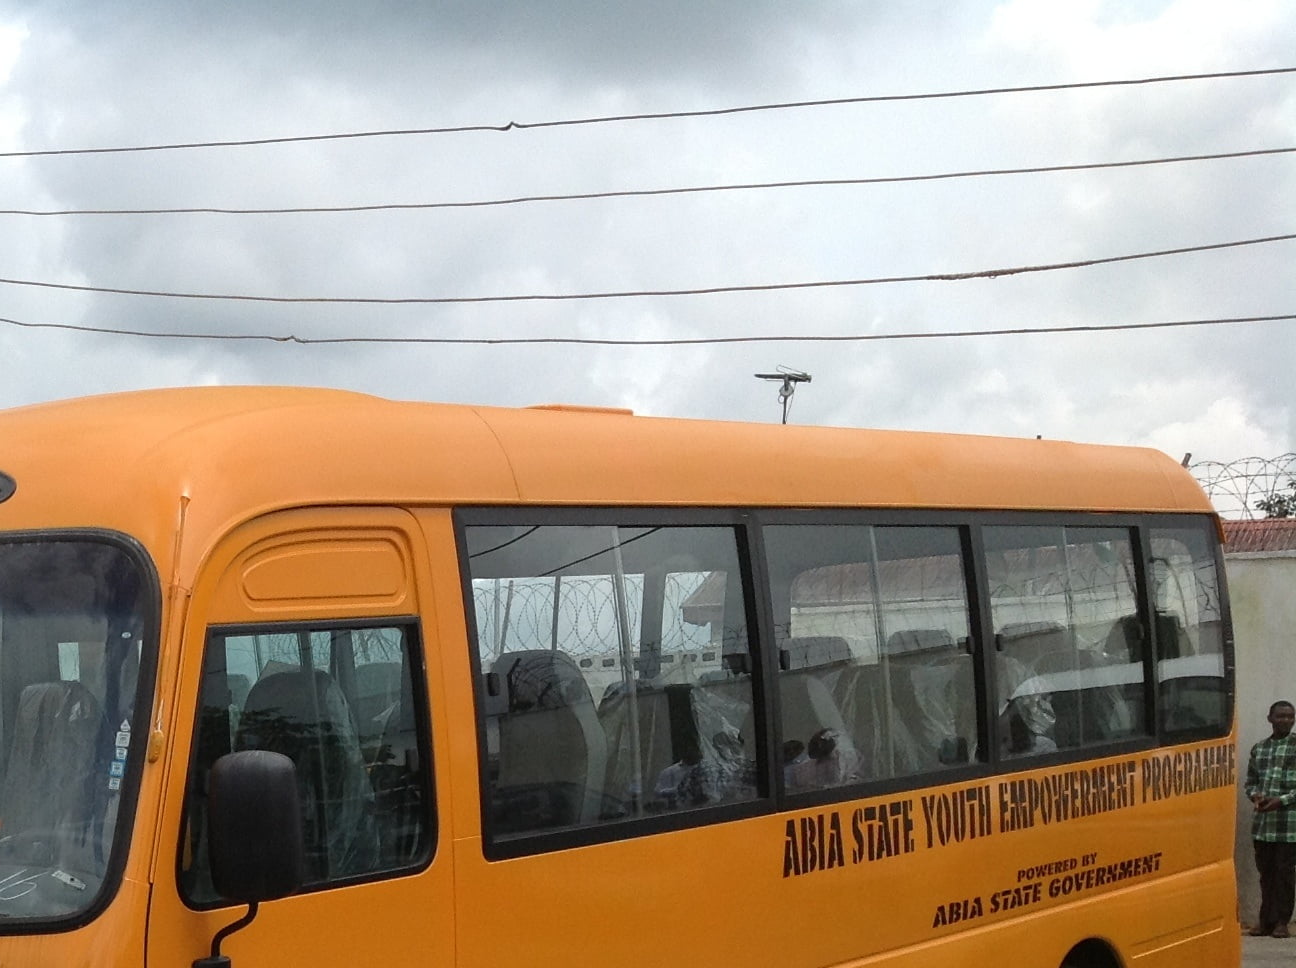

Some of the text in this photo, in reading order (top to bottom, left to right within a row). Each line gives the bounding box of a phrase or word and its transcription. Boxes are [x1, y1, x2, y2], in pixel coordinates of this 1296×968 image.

[783, 743, 1235, 878] ABIA STATE YOUTH EMPOWERMENT PROGRAMME
[932, 852, 1162, 928] ABIA STATE GOVERNMENT
[1017, 852, 1097, 882] POWERED BY
